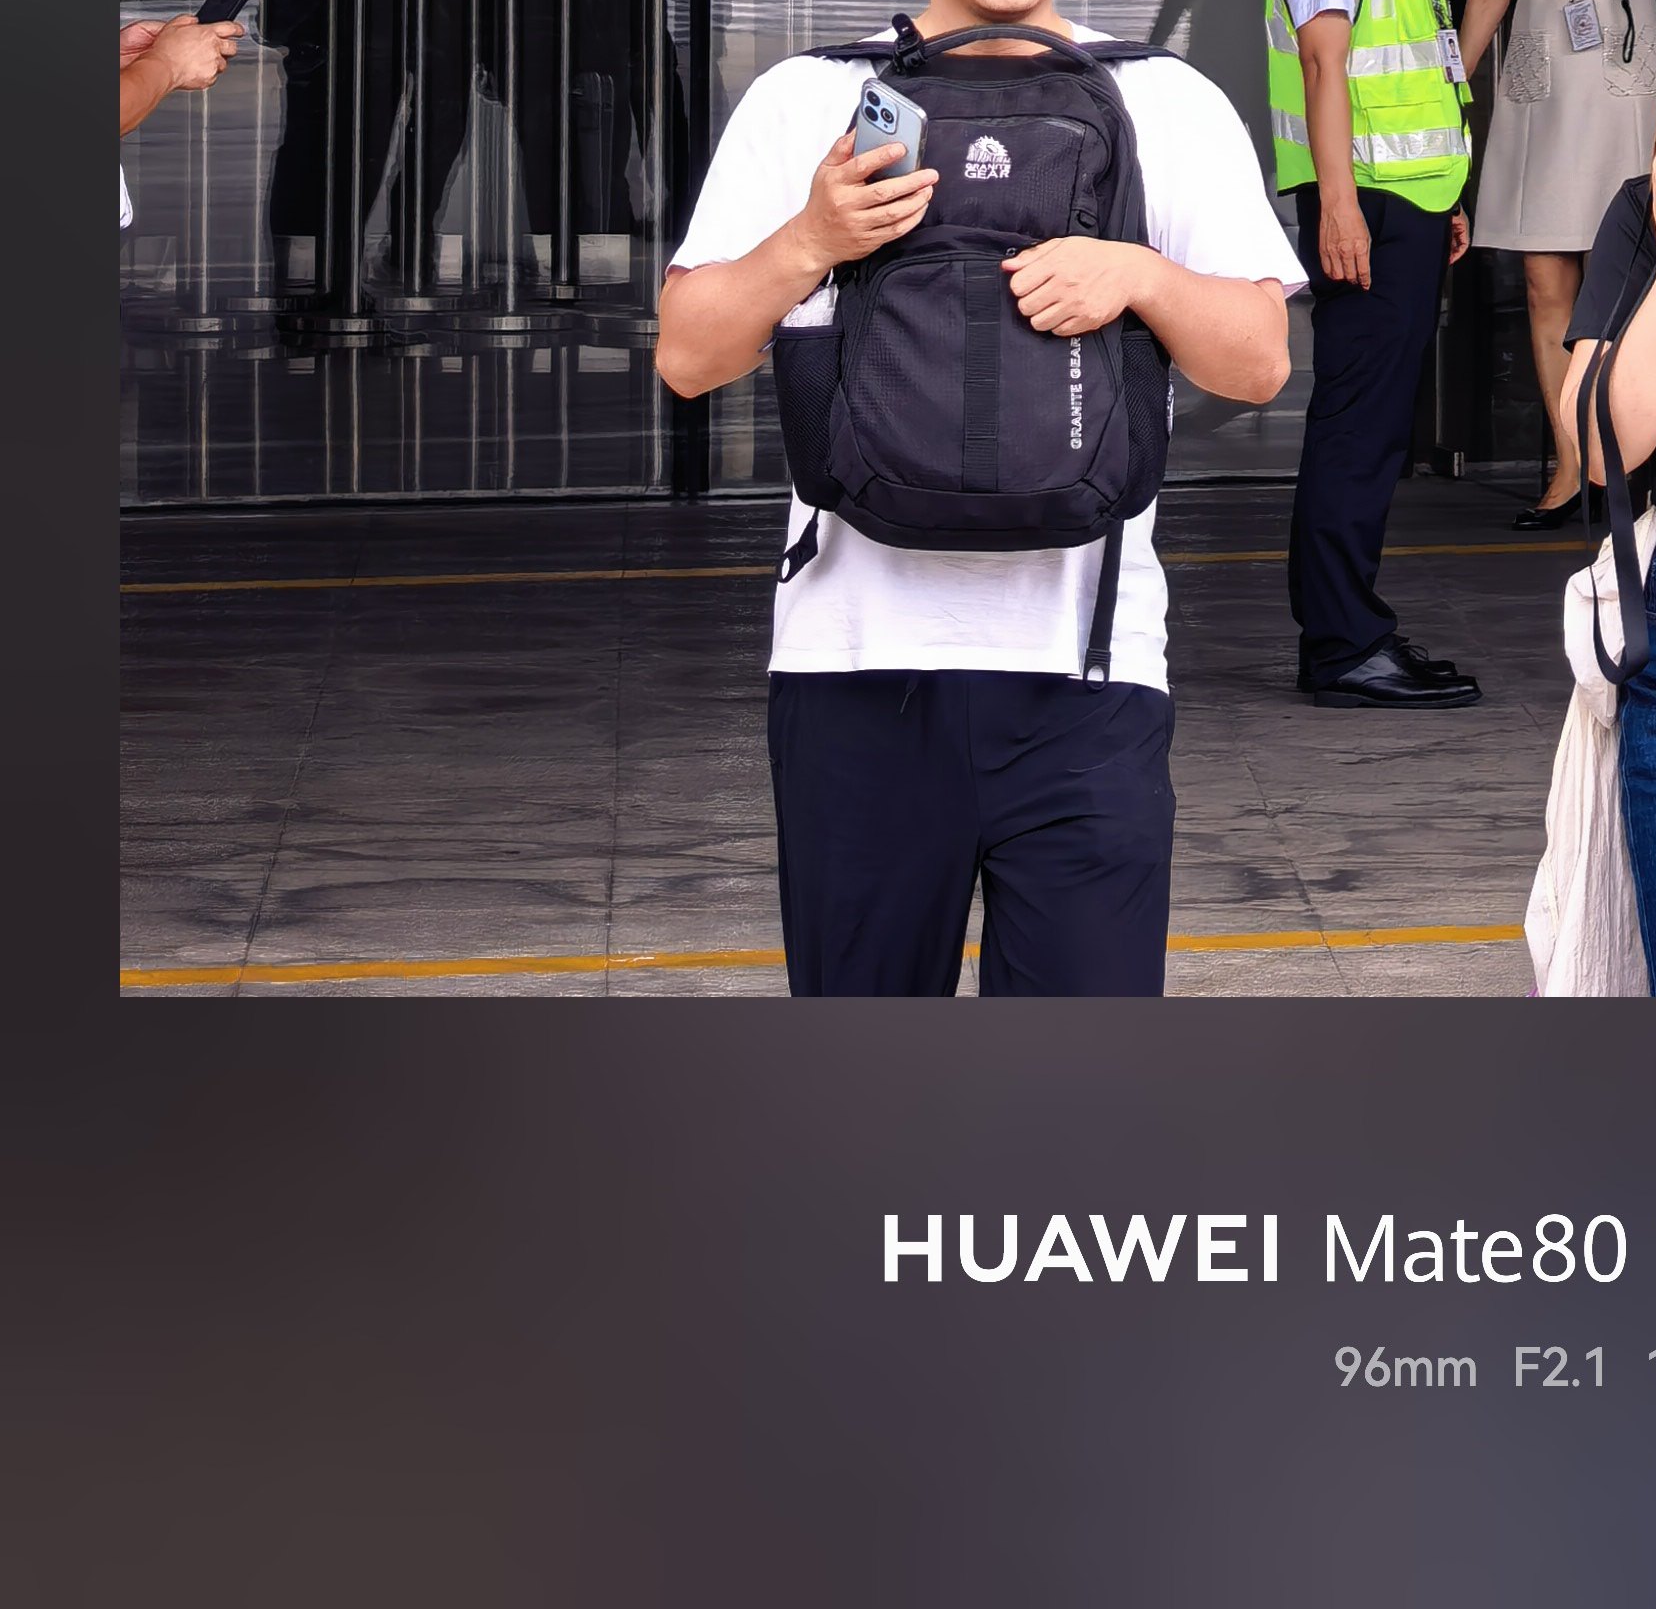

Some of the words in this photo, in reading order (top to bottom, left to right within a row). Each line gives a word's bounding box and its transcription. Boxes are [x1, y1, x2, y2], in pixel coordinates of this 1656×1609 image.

[964, 169, 1010, 180] GEAR
[965, 162, 1011, 170] GRANITE
[1070, 337, 1082, 379] GEAR
[1070, 383, 1083, 450] GRANITE
